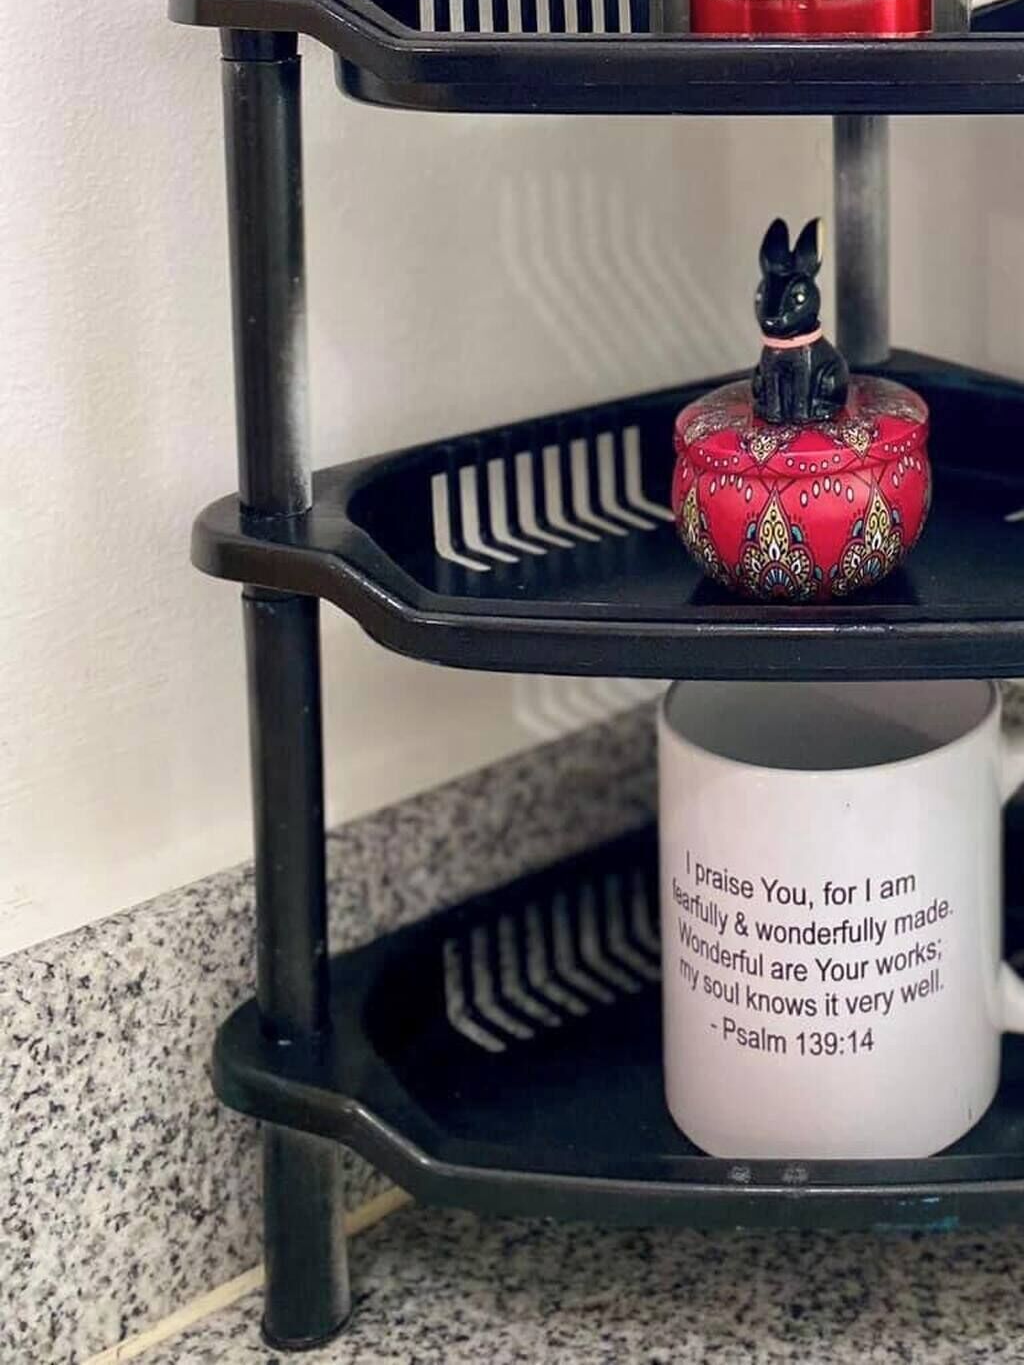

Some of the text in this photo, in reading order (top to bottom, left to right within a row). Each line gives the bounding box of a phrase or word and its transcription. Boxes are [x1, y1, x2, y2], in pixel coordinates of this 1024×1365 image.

[686, 850, 917, 911] I praise You, for I am
[678, 917, 943, 982] Wonderful are Your works;
[734, 911, 749, 937] &
[755, 917, 887, 946] wonderfully
[894, 898, 954, 936] made.
[679, 957, 945, 1017] my soul knows it very well.
[723, 1017, 787, 1055] Psalm
[796, 1027, 875, 1056] 139:14
